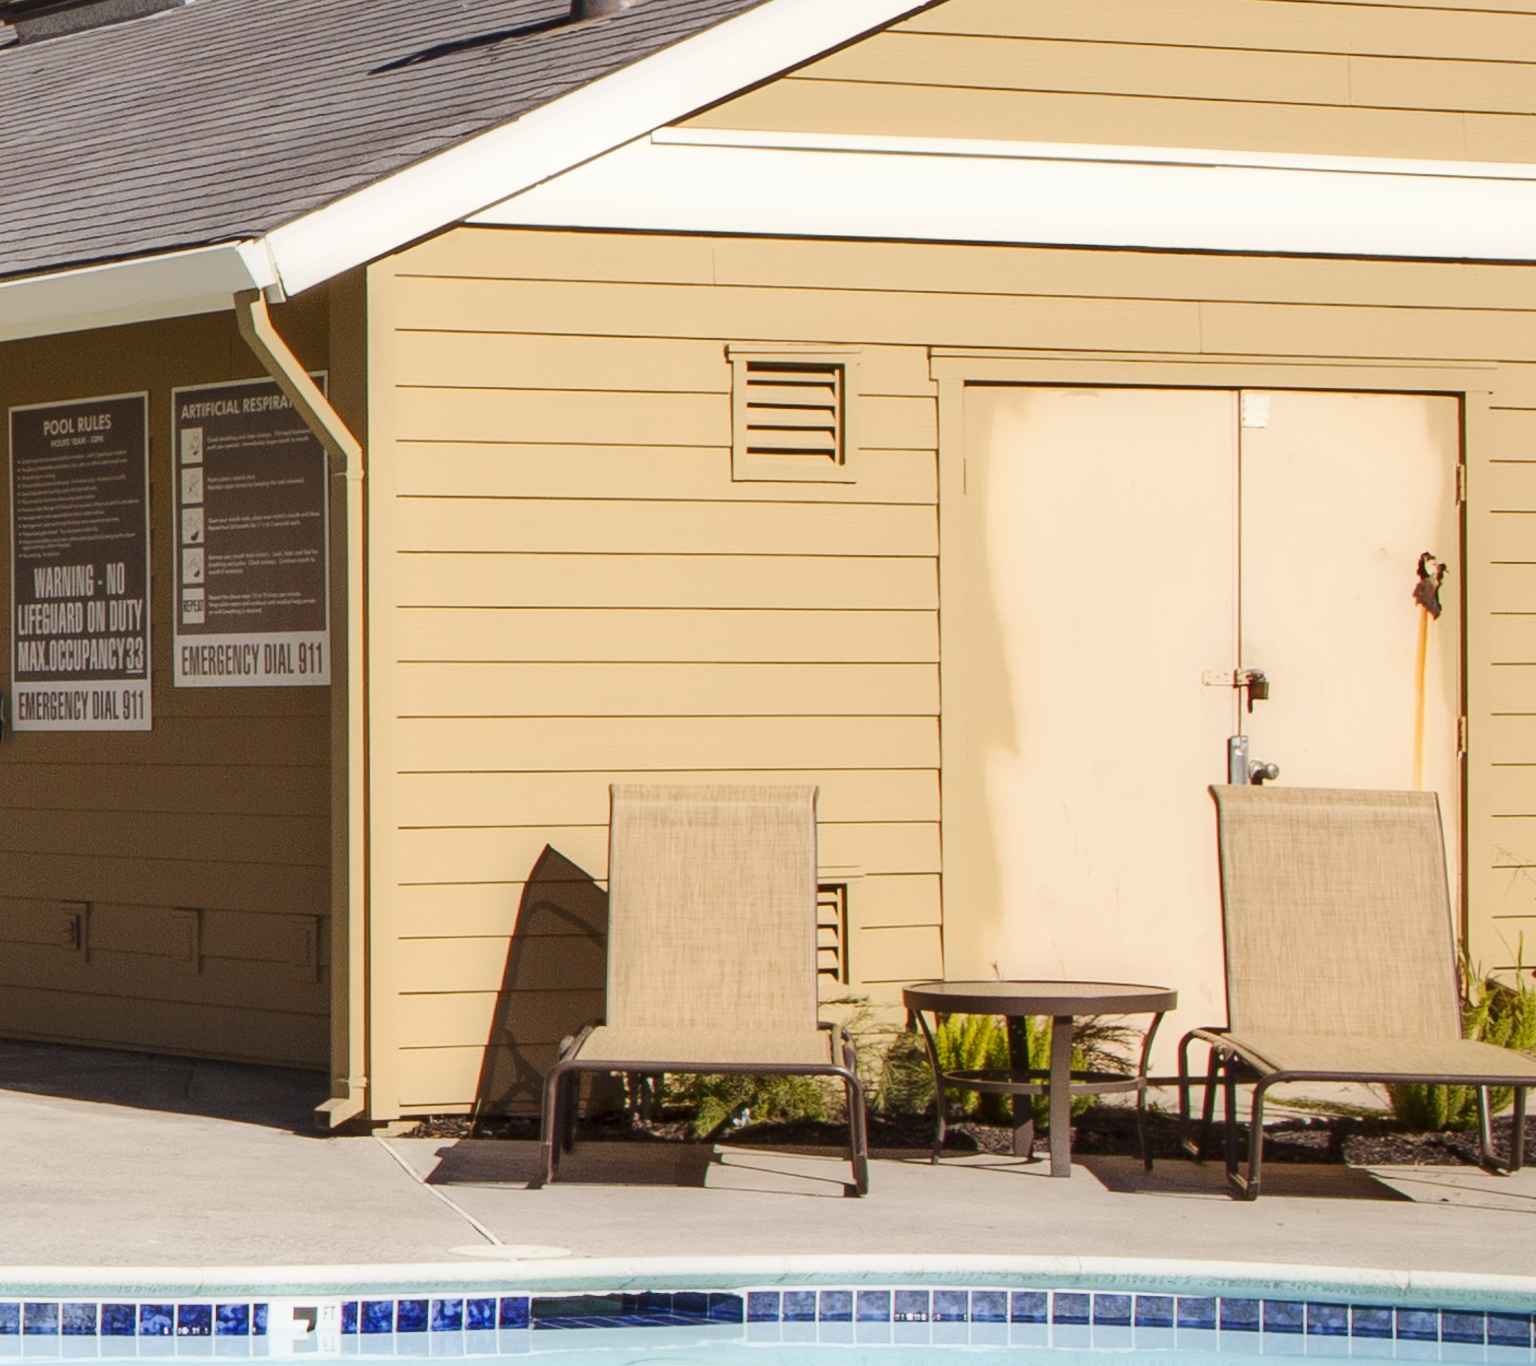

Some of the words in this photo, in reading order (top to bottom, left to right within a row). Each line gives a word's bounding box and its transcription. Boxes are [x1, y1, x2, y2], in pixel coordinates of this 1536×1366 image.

[43, 418, 75, 436] POOL
[77, 414, 112, 432] RULES
[180, 401, 239, 419] ARTIFICIAL
[34, 564, 94, 598] WARNING
[106, 562, 125, 595] NO
[18, 601, 83, 636] LIFEGUARD
[87, 600, 105, 633] ON
[109, 598, 143, 632] DUTY
[182, 643, 260, 676] EMERGENCY
[264, 643, 294, 675] DIAL
[298, 642, 322, 674] 911
[18, 690, 88, 721] EMERGENCY
[92, 690, 118, 721] DIAL
[122, 689, 145, 720] 911
[323, 1306, 336, 1322] FT
